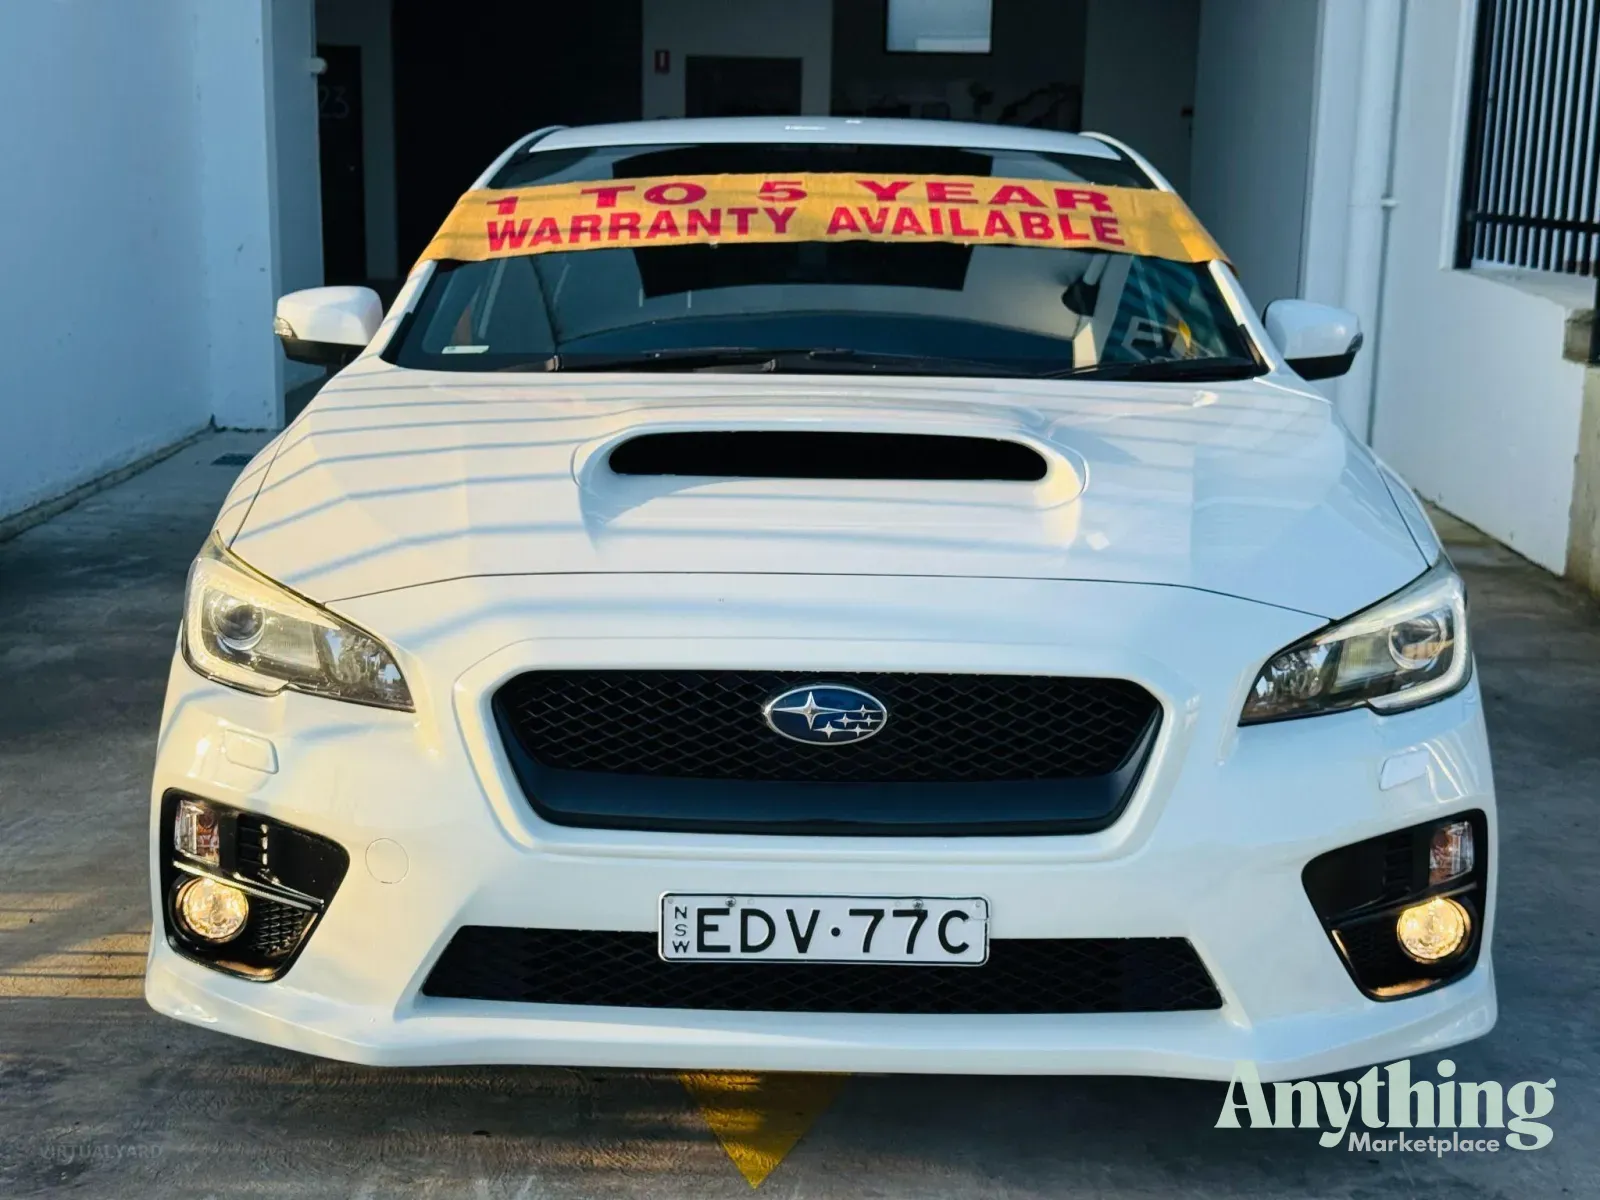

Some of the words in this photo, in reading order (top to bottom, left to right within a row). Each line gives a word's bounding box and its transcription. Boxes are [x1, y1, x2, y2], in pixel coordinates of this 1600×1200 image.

[487, 196, 518, 216] 1
[581, 182, 707, 209] TO
[757, 180, 808, 203] 5
[855, 180, 1114, 213] YEAR
[487, 206, 797, 252] WARRANTY
[826, 206, 1126, 246] AVAILABLE
